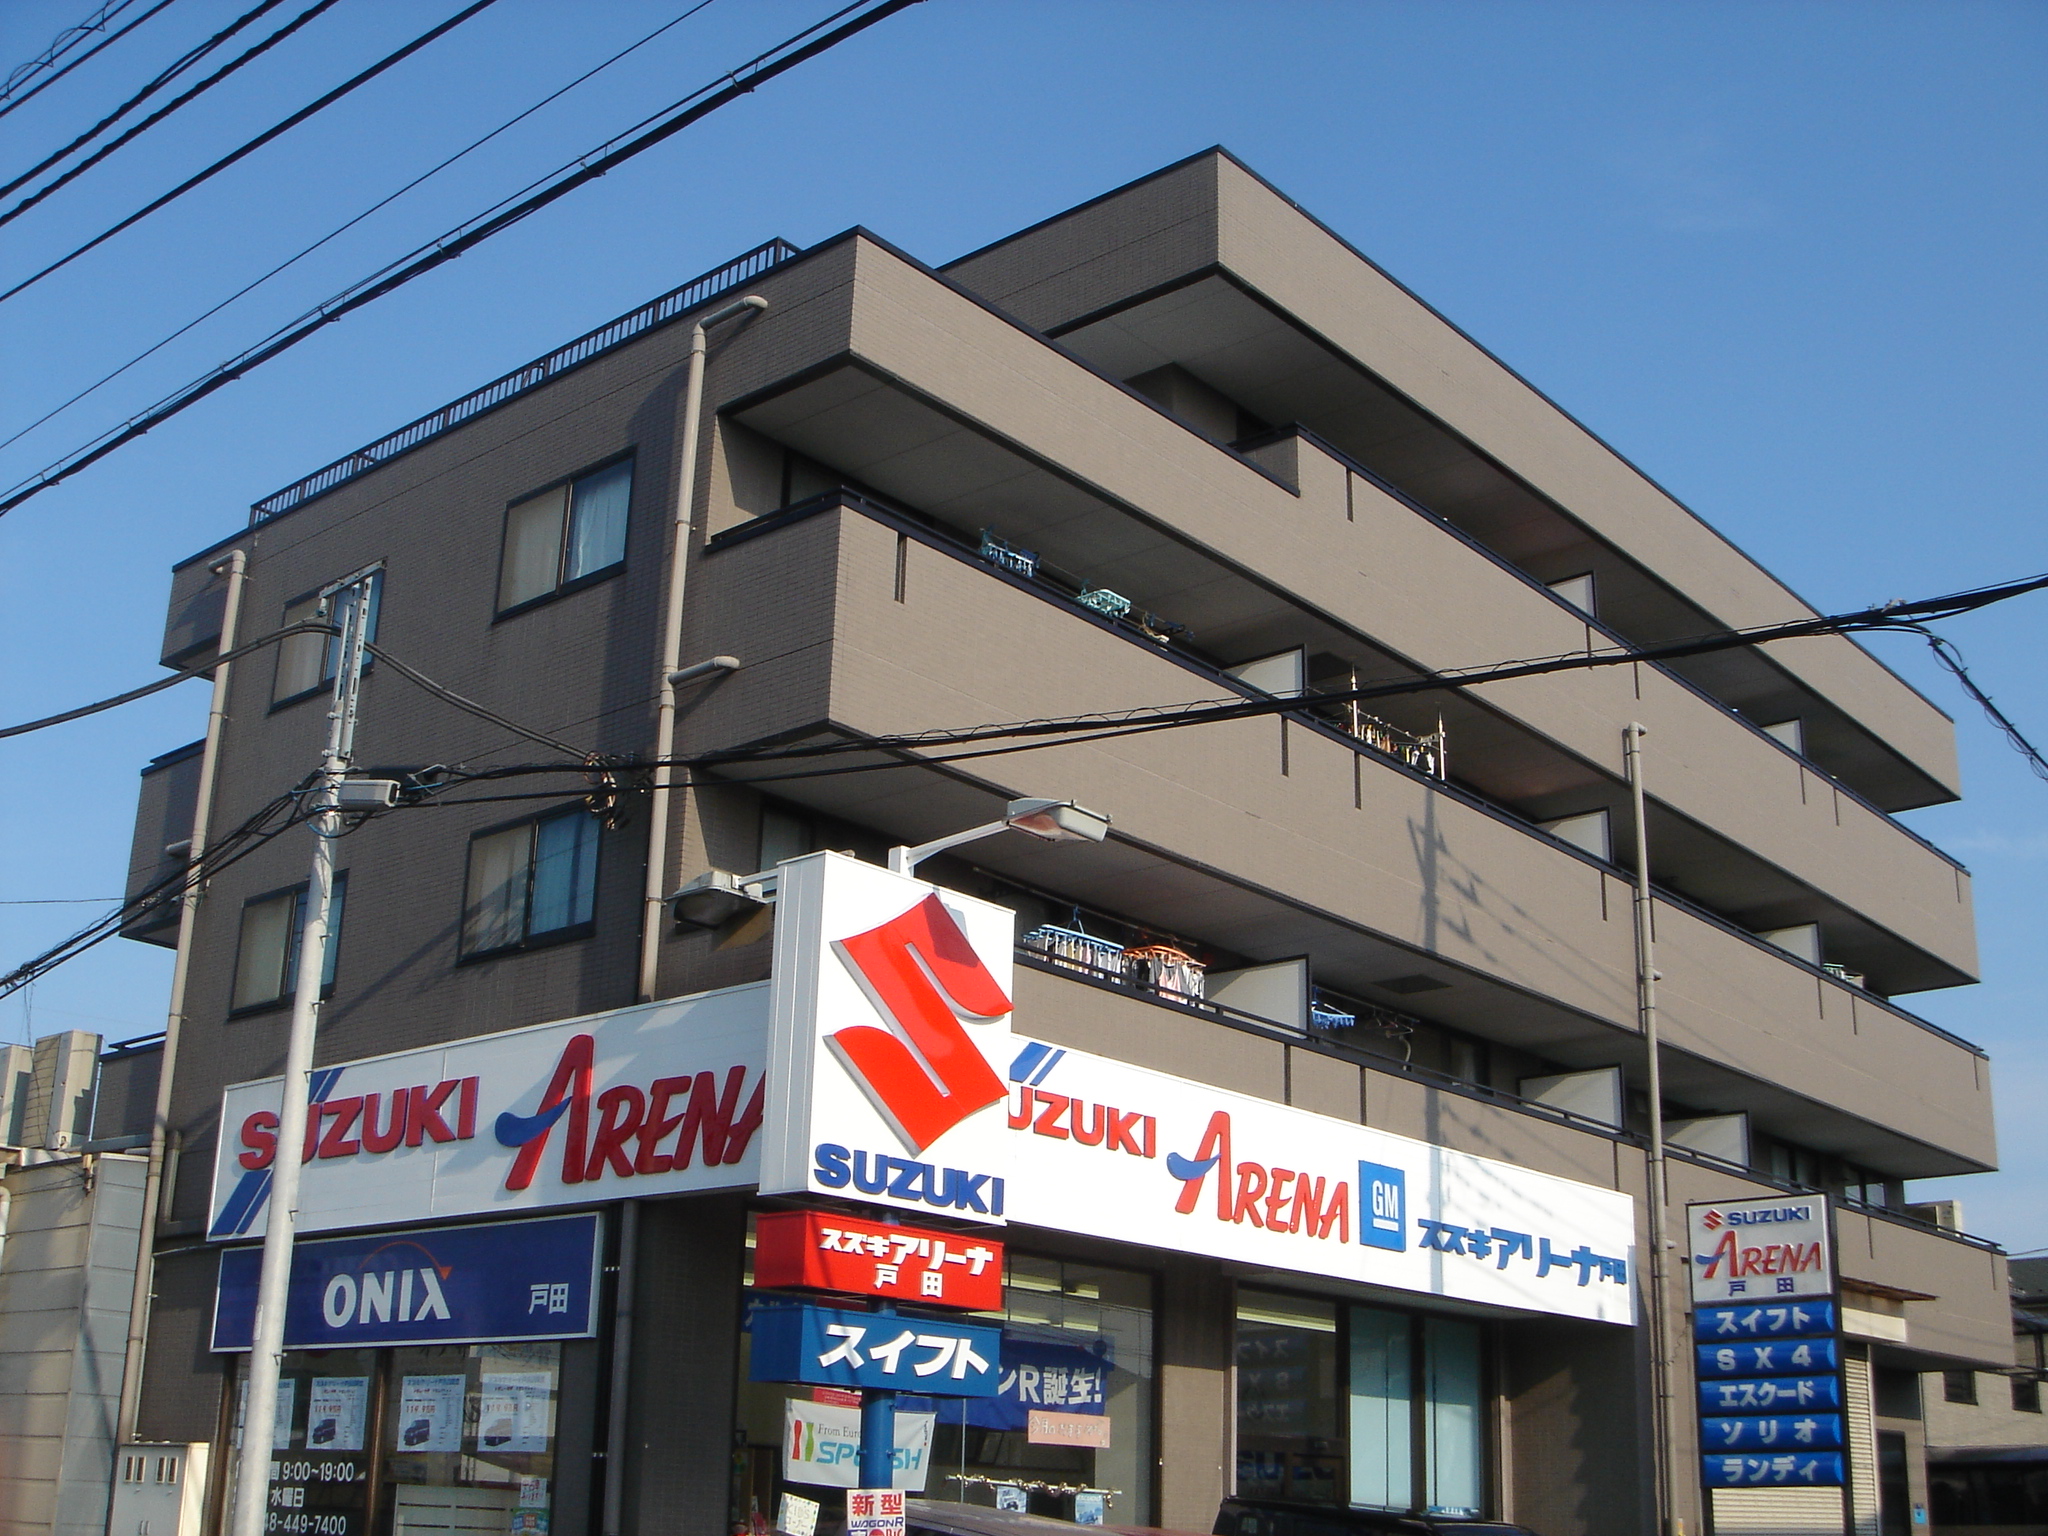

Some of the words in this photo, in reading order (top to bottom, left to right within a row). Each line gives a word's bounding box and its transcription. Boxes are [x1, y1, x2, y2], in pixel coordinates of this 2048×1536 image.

[813, 1143, 1005, 1216] SUZUKI
[1008, 1086, 1156, 1159] UZUKI
[1166, 1110, 1349, 1243] ARENA
[1372, 1179, 1399, 1220] GM
[1727, 1205, 1811, 1227] SUZUKI
[819, 1228, 993, 1276] スズキアリーナ
[1695, 1229, 1823, 1280] ARENA
[874, 1264, 943, 1298] 戸田
[1728, 1276, 1795, 1297] 戸田
[323, 1267, 451, 1328] ONIX
[528, 1282, 569, 1315] 戸田
[1716, 1306, 1810, 1335] スイフト
[818, 1323, 989, 1380] スイフト
[1718, 1380, 1815, 1408] エスクード
[818, 1423, 840, 1436] From
[1721, 1417, 1816, 1445] ソリオ
[1722, 1454, 1818, 1482] ランディ
[271, 1486, 305, 1508] 水曜日
[852, 1494, 903, 1517] 新型
